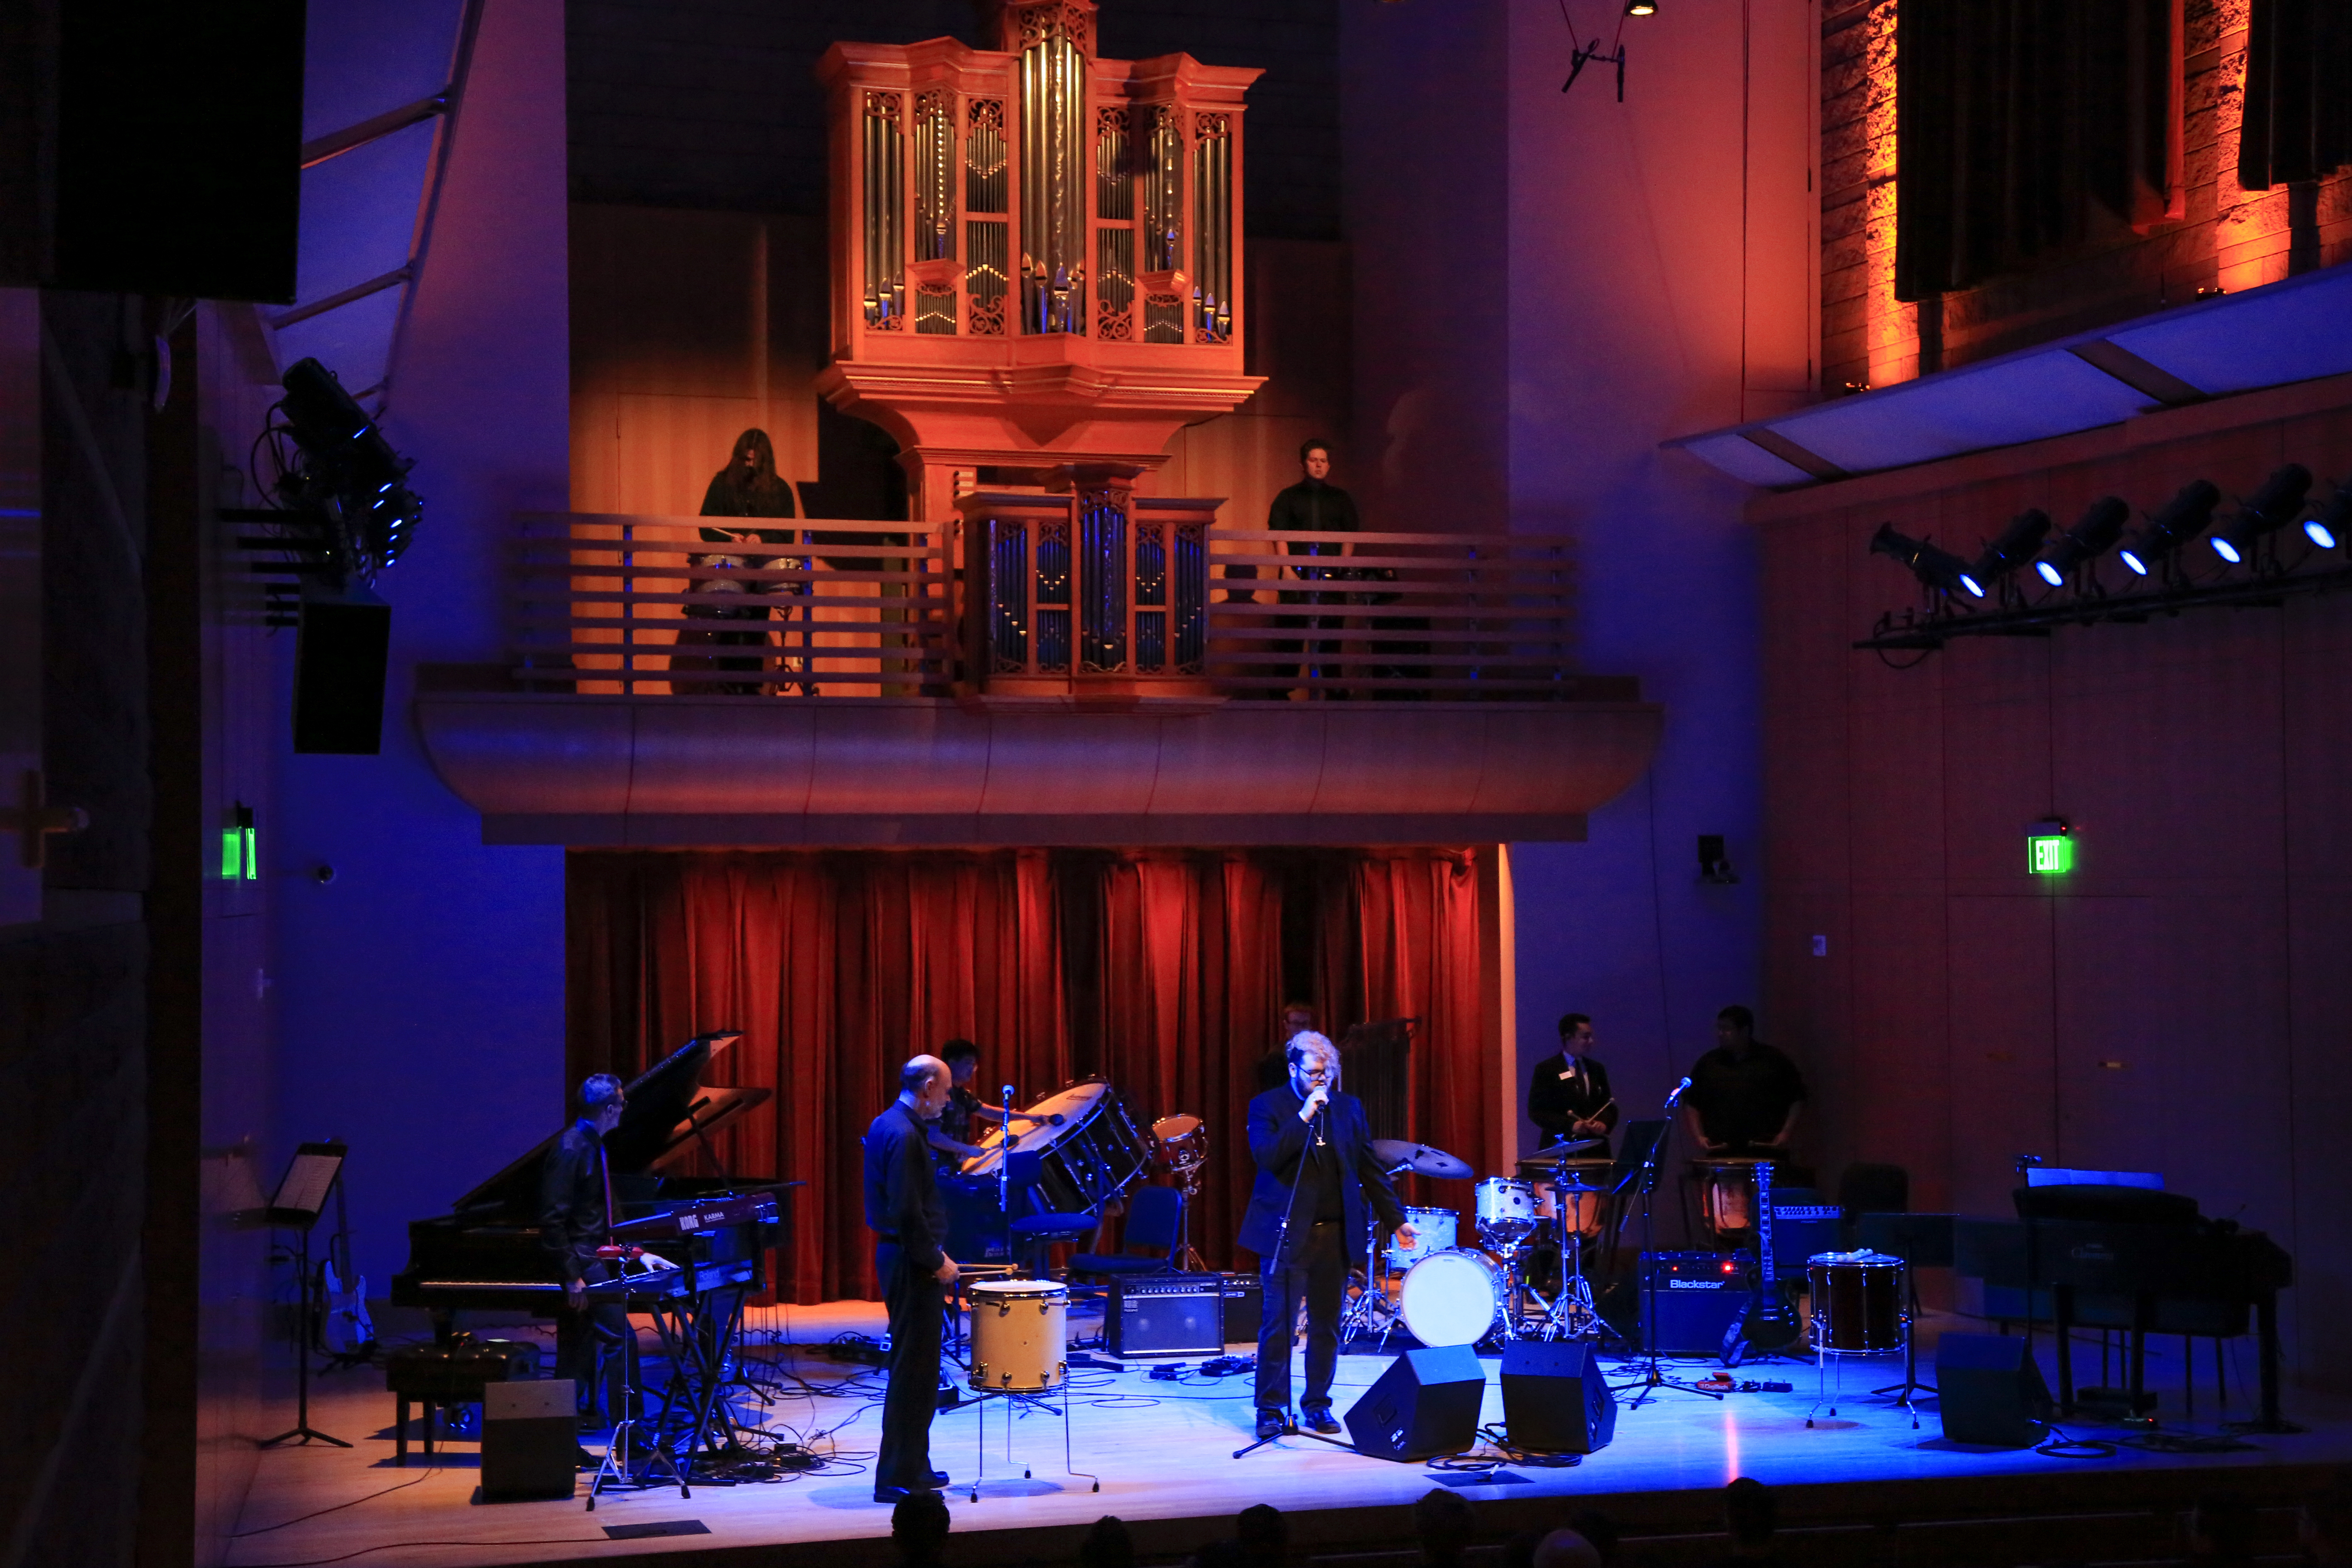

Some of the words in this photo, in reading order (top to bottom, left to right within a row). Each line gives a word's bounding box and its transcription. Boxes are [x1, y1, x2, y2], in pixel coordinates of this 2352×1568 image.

[2035, 840, 2059, 870] EXIT
[679, 1214, 699, 1230] KORG
[704, 1212, 724, 1221] KARMA
[1670, 1279, 1723, 1289] Blackstar
